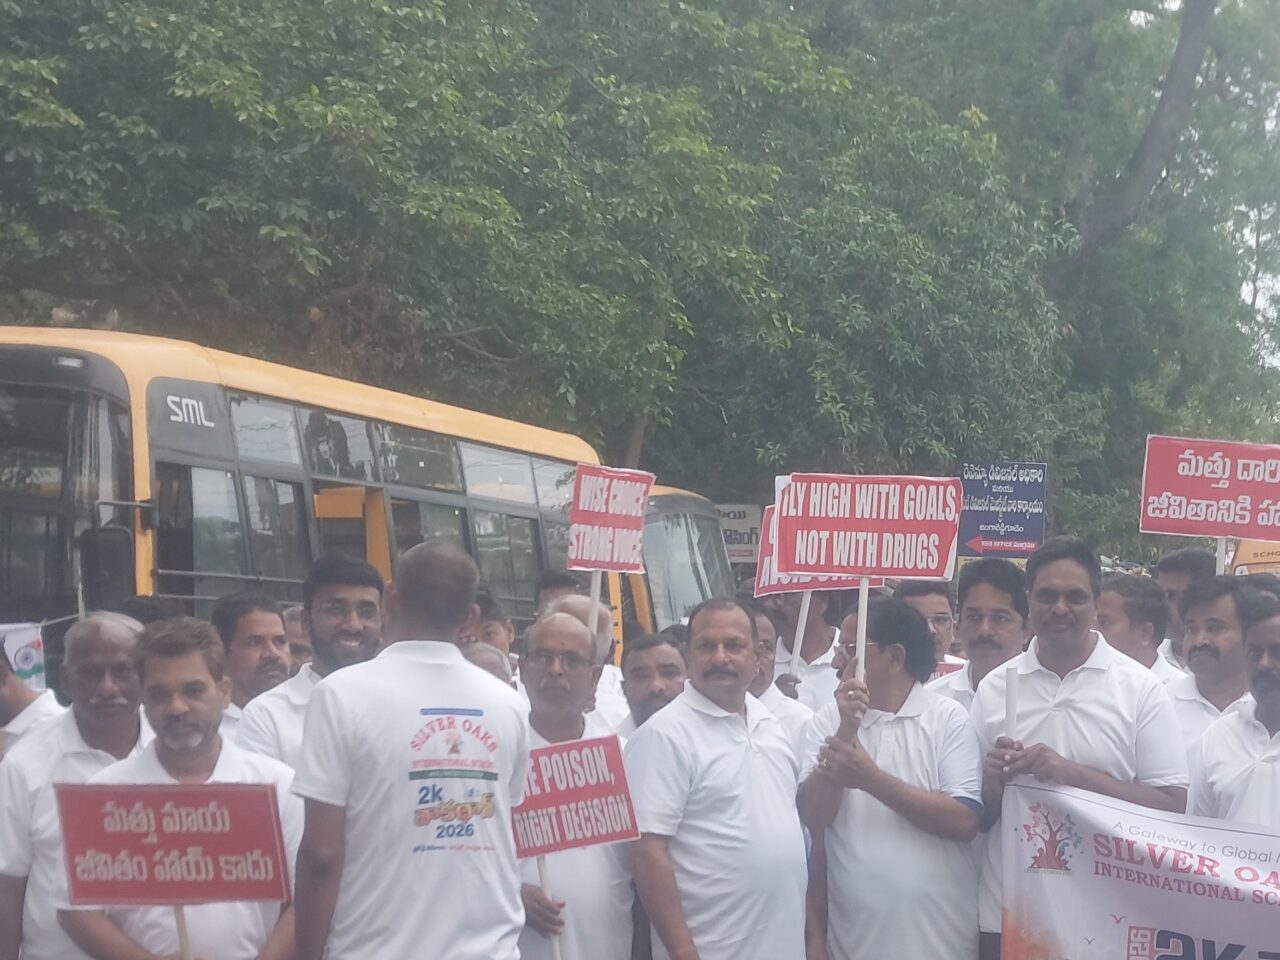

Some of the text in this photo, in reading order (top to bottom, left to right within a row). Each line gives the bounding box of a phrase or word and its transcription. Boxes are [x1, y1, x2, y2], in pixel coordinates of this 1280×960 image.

[166, 395, 215, 427] SML
[1177, 449, 1231, 488] మత్తు
[578, 474, 610, 513] WISE
[808, 482, 851, 519] HIGH
[855, 484, 900, 520] WITH
[903, 484, 960, 526] GOALS,
[1147, 491, 1252, 524] జీవితానికి
[795, 529, 829, 566] NOT
[832, 530, 878, 568] WITH
[881, 532, 940, 570] DRUGS
[538, 745, 615, 793] POISON,
[103, 800, 230, 844] మత్తు మాయ
[436, 823, 474, 839] 2026
[514, 793, 633, 848] RIGHT DECISION
[1093, 833, 1221, 878] SILVER
[1112, 821, 1124, 831] A
[1128, 825, 1198, 850] Gateway
[1202, 841, 1216, 854] to
[1221, 845, 1272, 863] Global
[75, 849, 147, 882] జీవితం
[219, 849, 273, 882] కాదు
[1093, 861, 1245, 902] INTERNATIONAL
